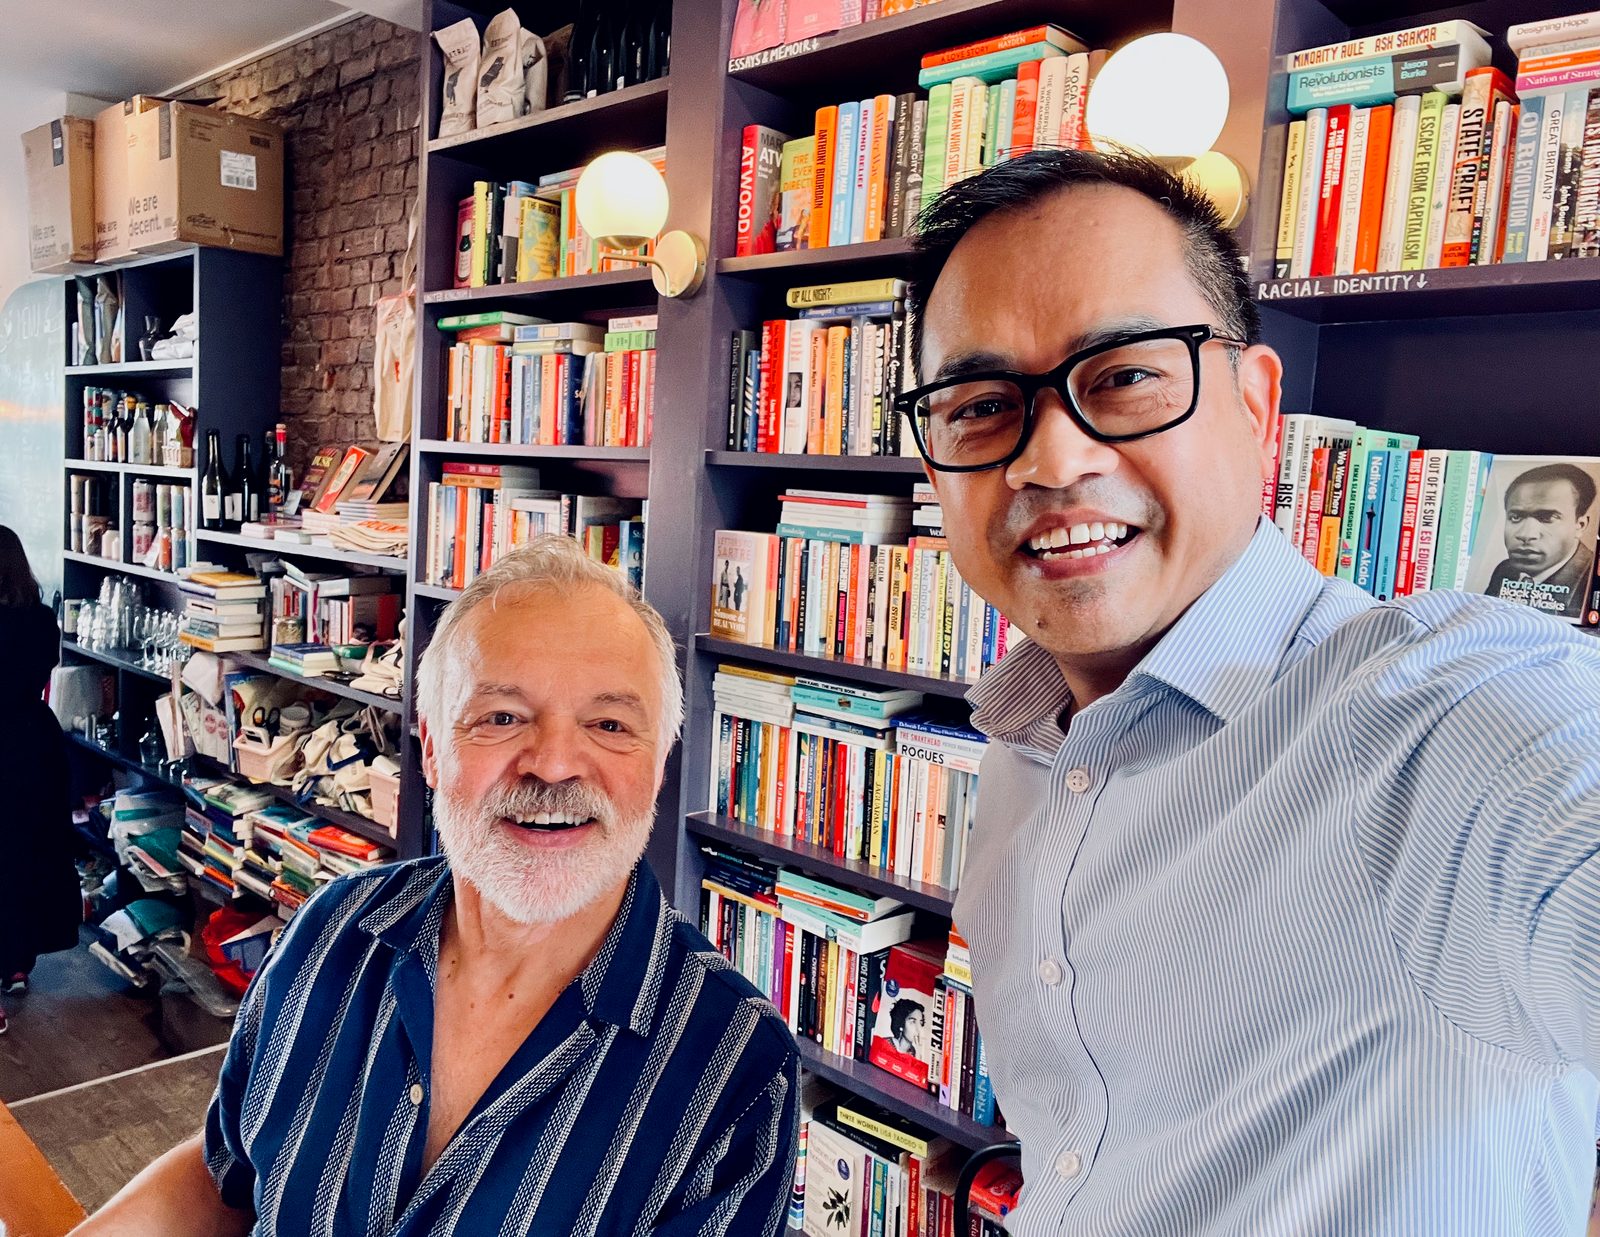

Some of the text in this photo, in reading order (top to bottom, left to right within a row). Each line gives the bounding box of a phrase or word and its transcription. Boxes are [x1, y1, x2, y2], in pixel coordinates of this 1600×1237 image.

[998, 37, 1026, 49] HAYDEN
[1517, 18, 1589, 35] Designing Hope
[728, 41, 809, 72] ESSAYS & MEMOIR
[947, 46, 989, 61] LOVE STORY
[1293, 26, 1437, 68] MINORITY RULE ASH SARKAR
[1300, 65, 1385, 89] Revolutionists
[1401, 60, 1428, 70] Jason
[1401, 69, 1427, 80] Burke
[1526, 71, 1569, 86] Nation of
[1069, 66, 1080, 109] VOCAL
[947, 92, 965, 179] THE MAN WHO STOLE
[1419, 116, 1436, 157] ESCAPE
[1458, 109, 1484, 159] STATE
[1521, 112, 1539, 137] ON
[857, 110, 868, 190] BEYOND BELIEF
[896, 124, 906, 166] BENNETT
[910, 121, 921, 174] LONELY CITY
[1331, 128, 1345, 186] THE BONFIRE
[1542, 110, 1561, 200] GREAT BRITAIN?
[815, 129, 828, 209] ANTHONY BOURDAIN
[1322, 131, 1336, 198] THE INSANITIES
[1345, 114, 1366, 216] FOR THE PEOPLE
[1414, 160, 1431, 194] FROM
[128, 193, 158, 215] We are
[738, 146, 754, 233] ATWOOD
[893, 172, 901, 206] ENOUGH
[1285, 173, 1294, 212] MOVEMENTS
[1576, 169, 1598, 228] WORKING?
[32, 224, 44, 240] We
[128, 216, 162, 237] decent.
[1404, 195, 1426, 261] CAPITALISM
[1555, 186, 1571, 244] John Boughton
[791, 292, 800, 304] UP
[800, 290, 812, 302] ALL
[1258, 274, 1414, 300] RACIAL IDENTITY
[731, 338, 740, 365] Ghost
[889, 320, 902, 389] Becoming George
[729, 367, 739, 400] Stories
[1390, 455, 1402, 502] Black England
[1410, 457, 1422, 473] THIS
[1276, 483, 1294, 509] RISE
[1331, 450, 1347, 516] We Were There
[1350, 483, 1358, 501] SLADE
[1406, 482, 1419, 500] WHY
[1308, 490, 1322, 538] LOUD BLACK
[1345, 502, 1355, 540] EDMONDSON
[1358, 456, 1384, 586] Natives Akala
[1402, 504, 1414, 528] RESIST
[1414, 456, 1441, 590] OUT OF THE SUN ESI EDUGYAN
[1443, 535, 1454, 561] EKOW
[911, 584, 919, 619] DIDION
[920, 555, 930, 620] JOAN DIDION
[1500, 587, 1554, 601] Black Skin,
[1503, 578, 1569, 594] Frantz Fanon
[1530, 598, 1565, 611] Masks
[942, 606, 952, 656] SLUM BOY
[831, 685, 843, 693] WHITE
[899, 721, 918, 730] Deborah
[900, 731, 941, 747] THE SNAKEHEAD
[902, 744, 944, 764] ROGUES
[872, 781, 881, 835] JAGUARMAN
[785, 931, 794, 954] FALL
[856, 956, 868, 1046] SHOE DOG PHIL KNIGHT
[930, 1012, 944, 1050] FIVE
[840, 1111, 854, 1123] THREE
[857, 1118, 878, 1132] WOMEN
[880, 1128, 891, 1139] LISA
